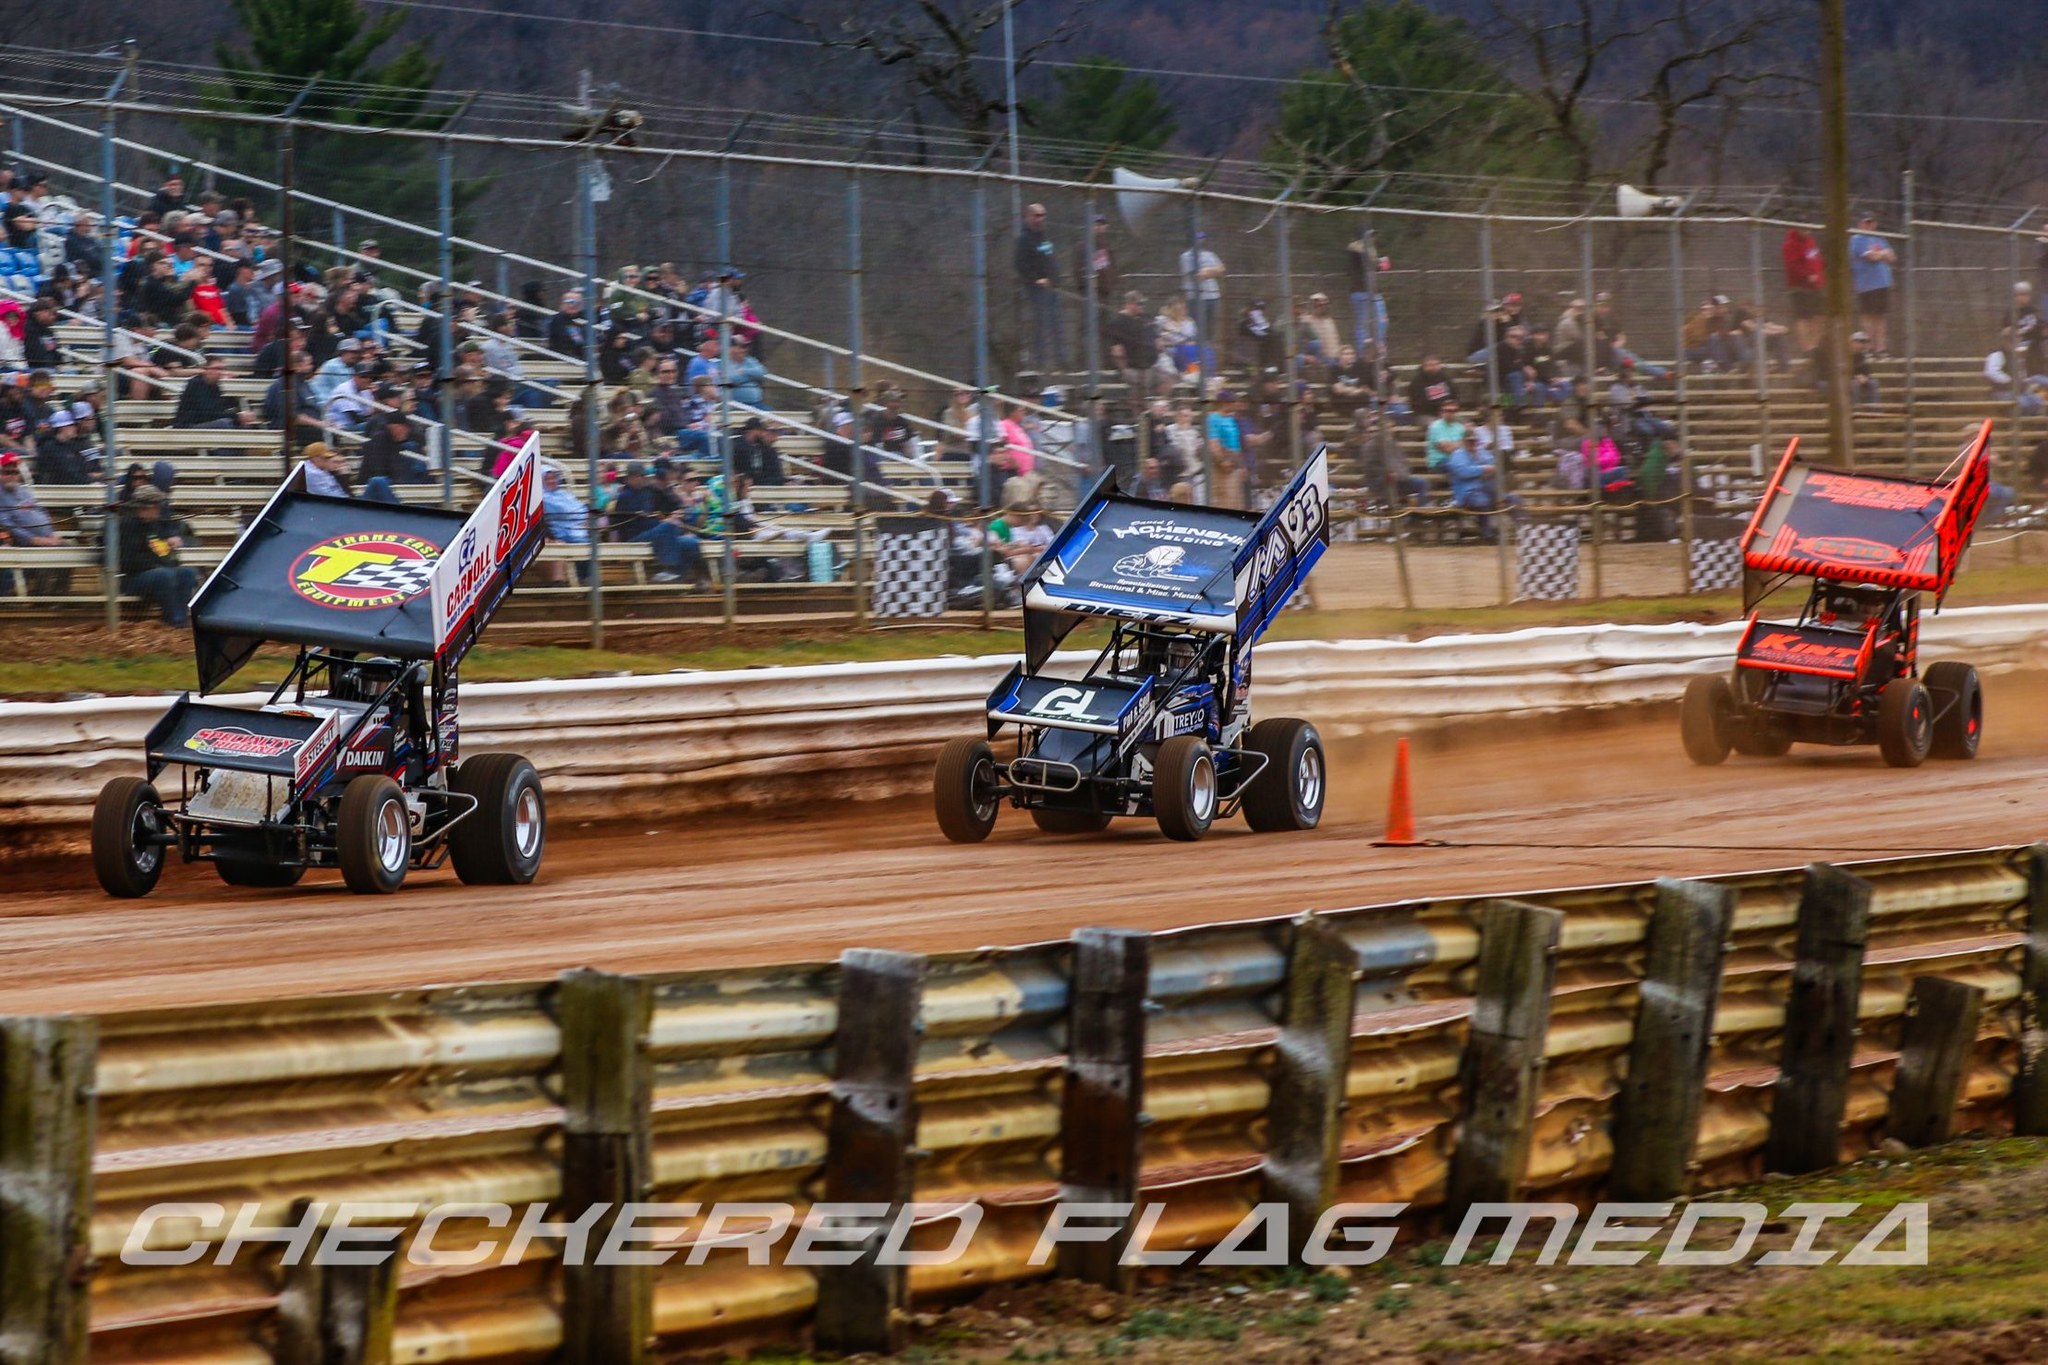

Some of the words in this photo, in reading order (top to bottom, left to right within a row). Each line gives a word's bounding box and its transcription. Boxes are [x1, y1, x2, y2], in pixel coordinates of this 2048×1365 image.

[494, 452, 535, 568] 51
[1287, 484, 1325, 551] 23
[332, 534, 399, 549] TRANS
[403, 537, 440, 558] EAST
[1112, 525, 1246, 547] HOHENSHI
[1149, 532, 1225, 547] WELDING
[296, 581, 406, 607] EQUIPMENT
[1088, 581, 1135, 593] Structural
[1063, 603, 1199, 626] DIETZ
[1029, 687, 1101, 720] GL
[196, 730, 297, 749] SPECIALTY
[345, 750, 385, 767] DAIKIN
